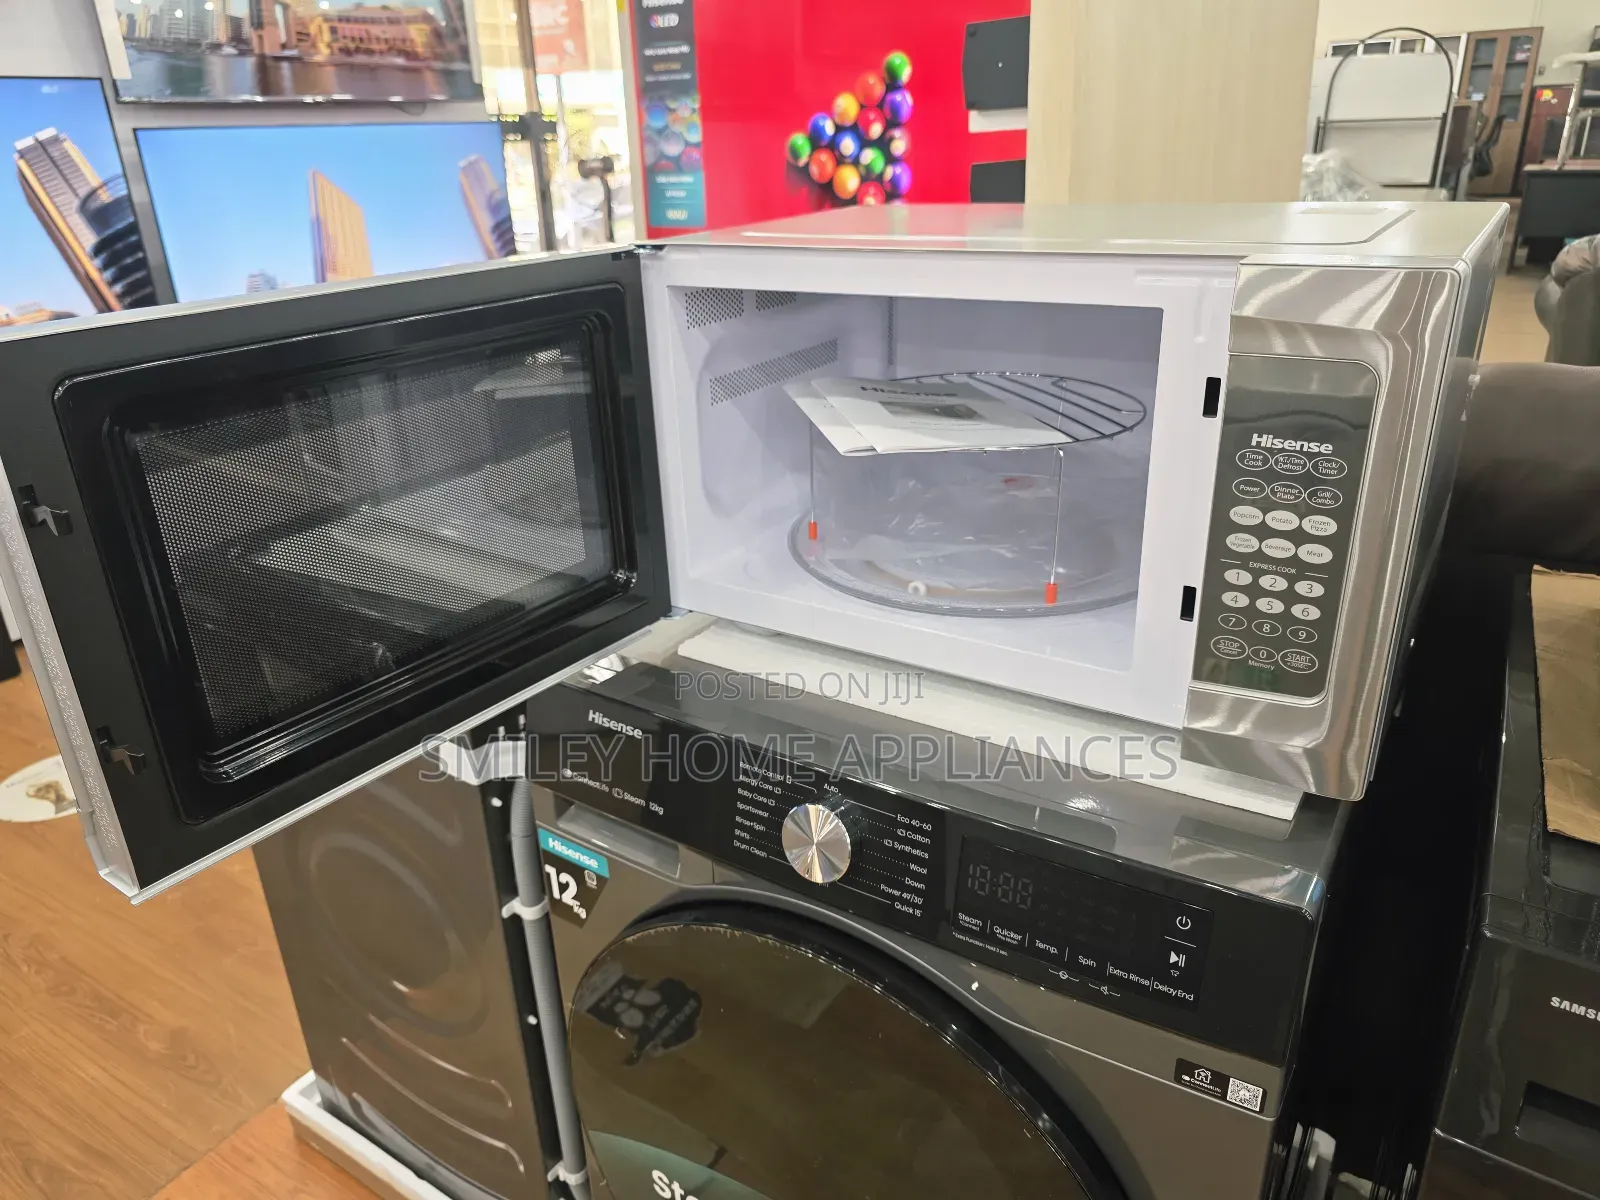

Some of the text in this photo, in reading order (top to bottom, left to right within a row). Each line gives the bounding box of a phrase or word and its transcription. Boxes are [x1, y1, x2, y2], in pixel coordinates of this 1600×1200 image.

[1250, 433, 1333, 454] Hisense
[1245, 452, 1264, 460] Time
[1244, 459, 1263, 467] Cook
[1277, 462, 1303, 471] Defrost
[1317, 466, 1339, 475] Timer
[1239, 484, 1261, 493] Power
[1274, 485, 1300, 495] Dinner
[1276, 491, 1295, 500] Plate
[1312, 496, 1335, 505] Combo
[1233, 510, 1260, 521] Popcorn
[1271, 516, 1293, 526] Potato
[1308, 518, 1331, 527] Frozen
[1310, 525, 1328, 533] Pizza
[1234, 535, 1252, 543] Frozen
[1264, 543, 1292, 553] Beverage
[1306, 549, 1324, 558] Meat
[1249, 561, 1297, 575] EXPRESS COOK
[1235, 571, 1241, 582] 1
[1268, 577, 1278, 589] 2
[1305, 583, 1314, 594] 3
[1230, 594, 1239, 605] 4
[1265, 600, 1274, 611] 5
[1301, 606, 1311, 618] 6
[1228, 617, 1236, 628] 7
[1262, 622, 1271, 633] 8
[1298, 630, 1307, 641] 9
[1219, 639, 1240, 649] STOP
[1259, 650, 1267, 659] 0
[1287, 652, 1311, 663] START
[1248, 659, 1275, 671] Memory
[588, 709, 643, 740] Hisense
[762, 769, 785, 782] Control
[739, 774, 773, 791] Allergy Care
[737, 787, 768, 803] Baby Care
[623, 792, 646, 807] Steam
[648, 801, 664, 816] 12kg
[736, 801, 769, 818] Sportswear
[735, 815, 766, 832] Rinse+Spin
[896, 813, 932, 831] Eco 40-60
[734, 828, 750, 840] Shirts
[906, 831, 931, 845] Cotton
[548, 837, 599, 868] Hisense
[733, 840, 768, 858] Drum Clean
[893, 841, 929, 859] Synthetics
[909, 862, 928, 875] Wool
[544, 863, 580, 906] 12
[905, 876, 926, 890] Down
[880, 883, 902, 897] Power
[894, 901, 914, 915] Quick
[958, 912, 983, 927] Steam
[993, 925, 1023, 941] Quicker
[1035, 940, 1059, 955] Temp.
[1078, 955, 1097, 968] Spin
[1109, 966, 1150, 986] Extra Rinse
[1153, 981, 1194, 1001] Delay End
